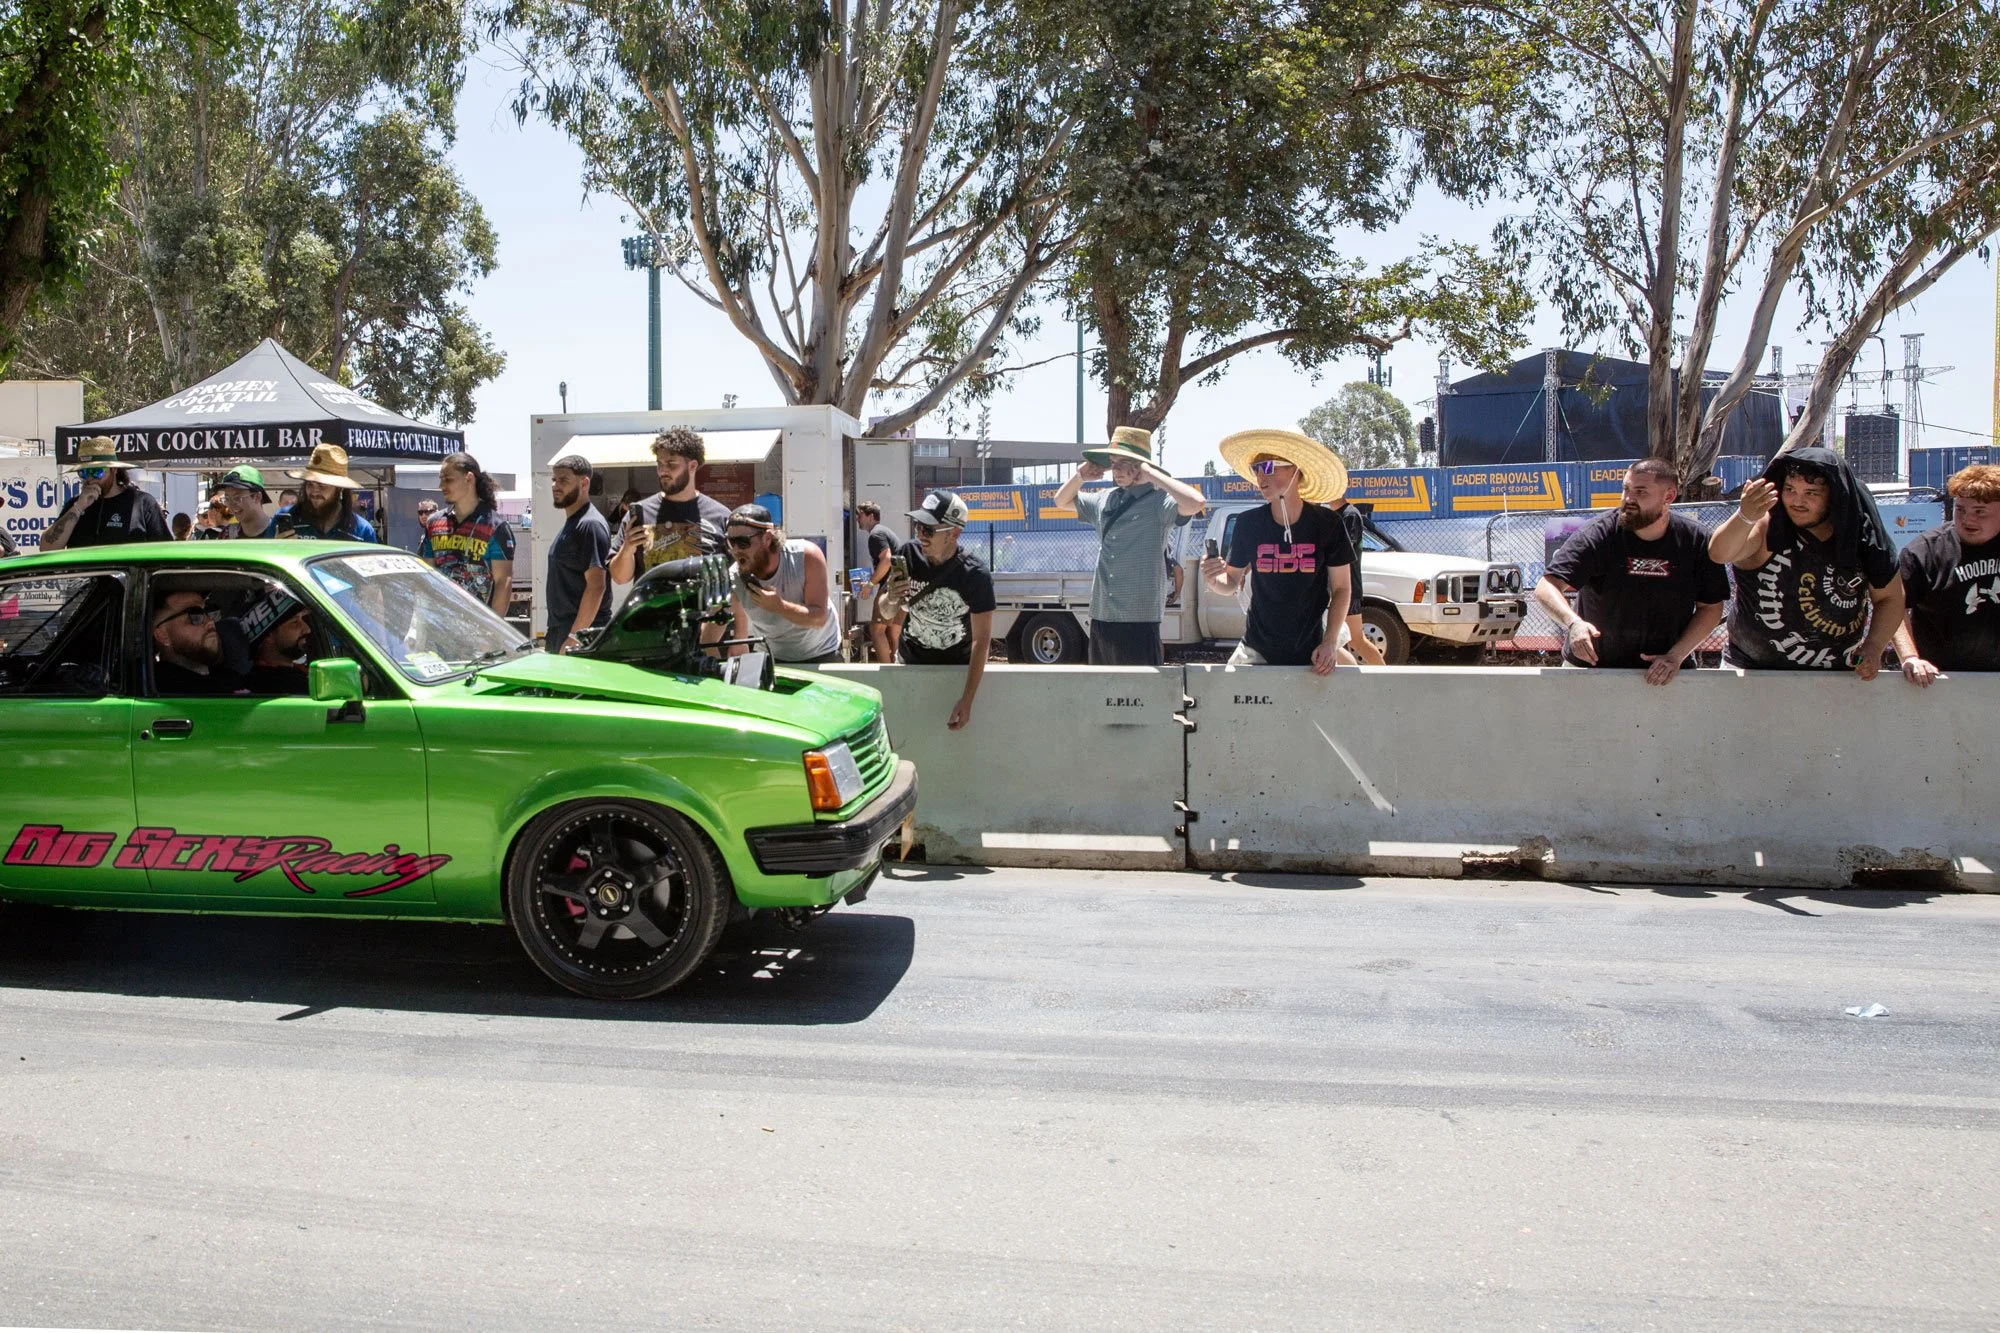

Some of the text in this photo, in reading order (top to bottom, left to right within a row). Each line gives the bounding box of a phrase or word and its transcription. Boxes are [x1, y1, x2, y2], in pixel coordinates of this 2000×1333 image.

[186, 381, 279, 397] FROZEN
[164, 392, 278, 409] COCKTAIL
[185, 403, 235, 415] BAR
[67, 428, 324, 456] FZEN COCKTAIL BAR
[348, 428, 460, 454] FROZEN COCKTAIL BAR
[1364, 475, 1408, 487] REMOVALS
[1452, 471, 1539, 485] LEADER REMOVALS
[1223, 482, 1251, 492] LEADER
[1365, 488, 1408, 496] and storage
[1491, 485, 1539, 494] and storage
[1256, 558, 1316, 573] SIDE
[1955, 558, 2000, 582] HOODRI
[1798, 572, 1846, 639] Celebrity
[1769, 631, 1837, 669] Ink
[1106, 697, 1144, 707] E.P.I.C.
[1232, 694, 1273, 705] E.P.I.C.
[3, 824, 117, 868] BIG
[235, 836, 453, 897] Racing
